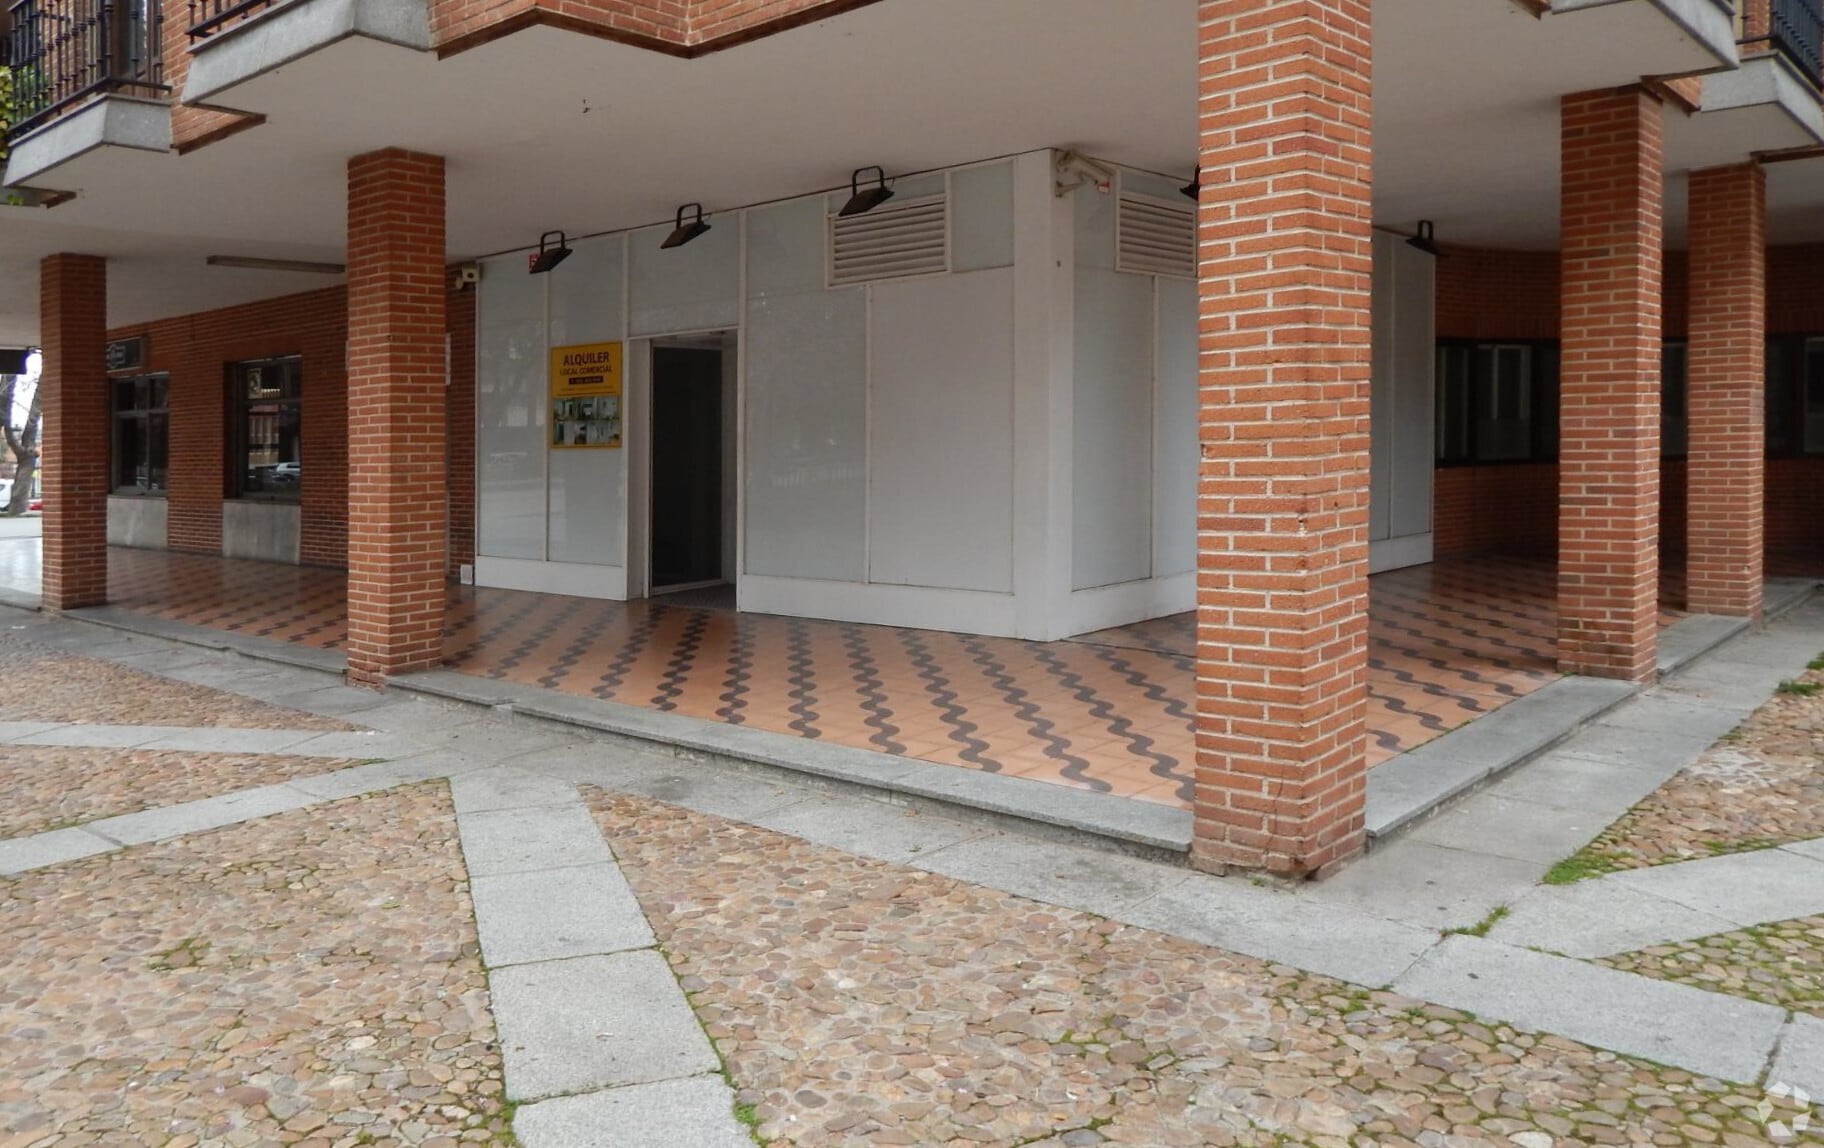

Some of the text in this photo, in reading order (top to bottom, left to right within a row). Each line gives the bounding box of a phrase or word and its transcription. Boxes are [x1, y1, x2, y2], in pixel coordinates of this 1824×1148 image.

[563, 351, 609, 366] ALQUILER
[560, 365, 612, 376] LOCAL COMERCIAL
